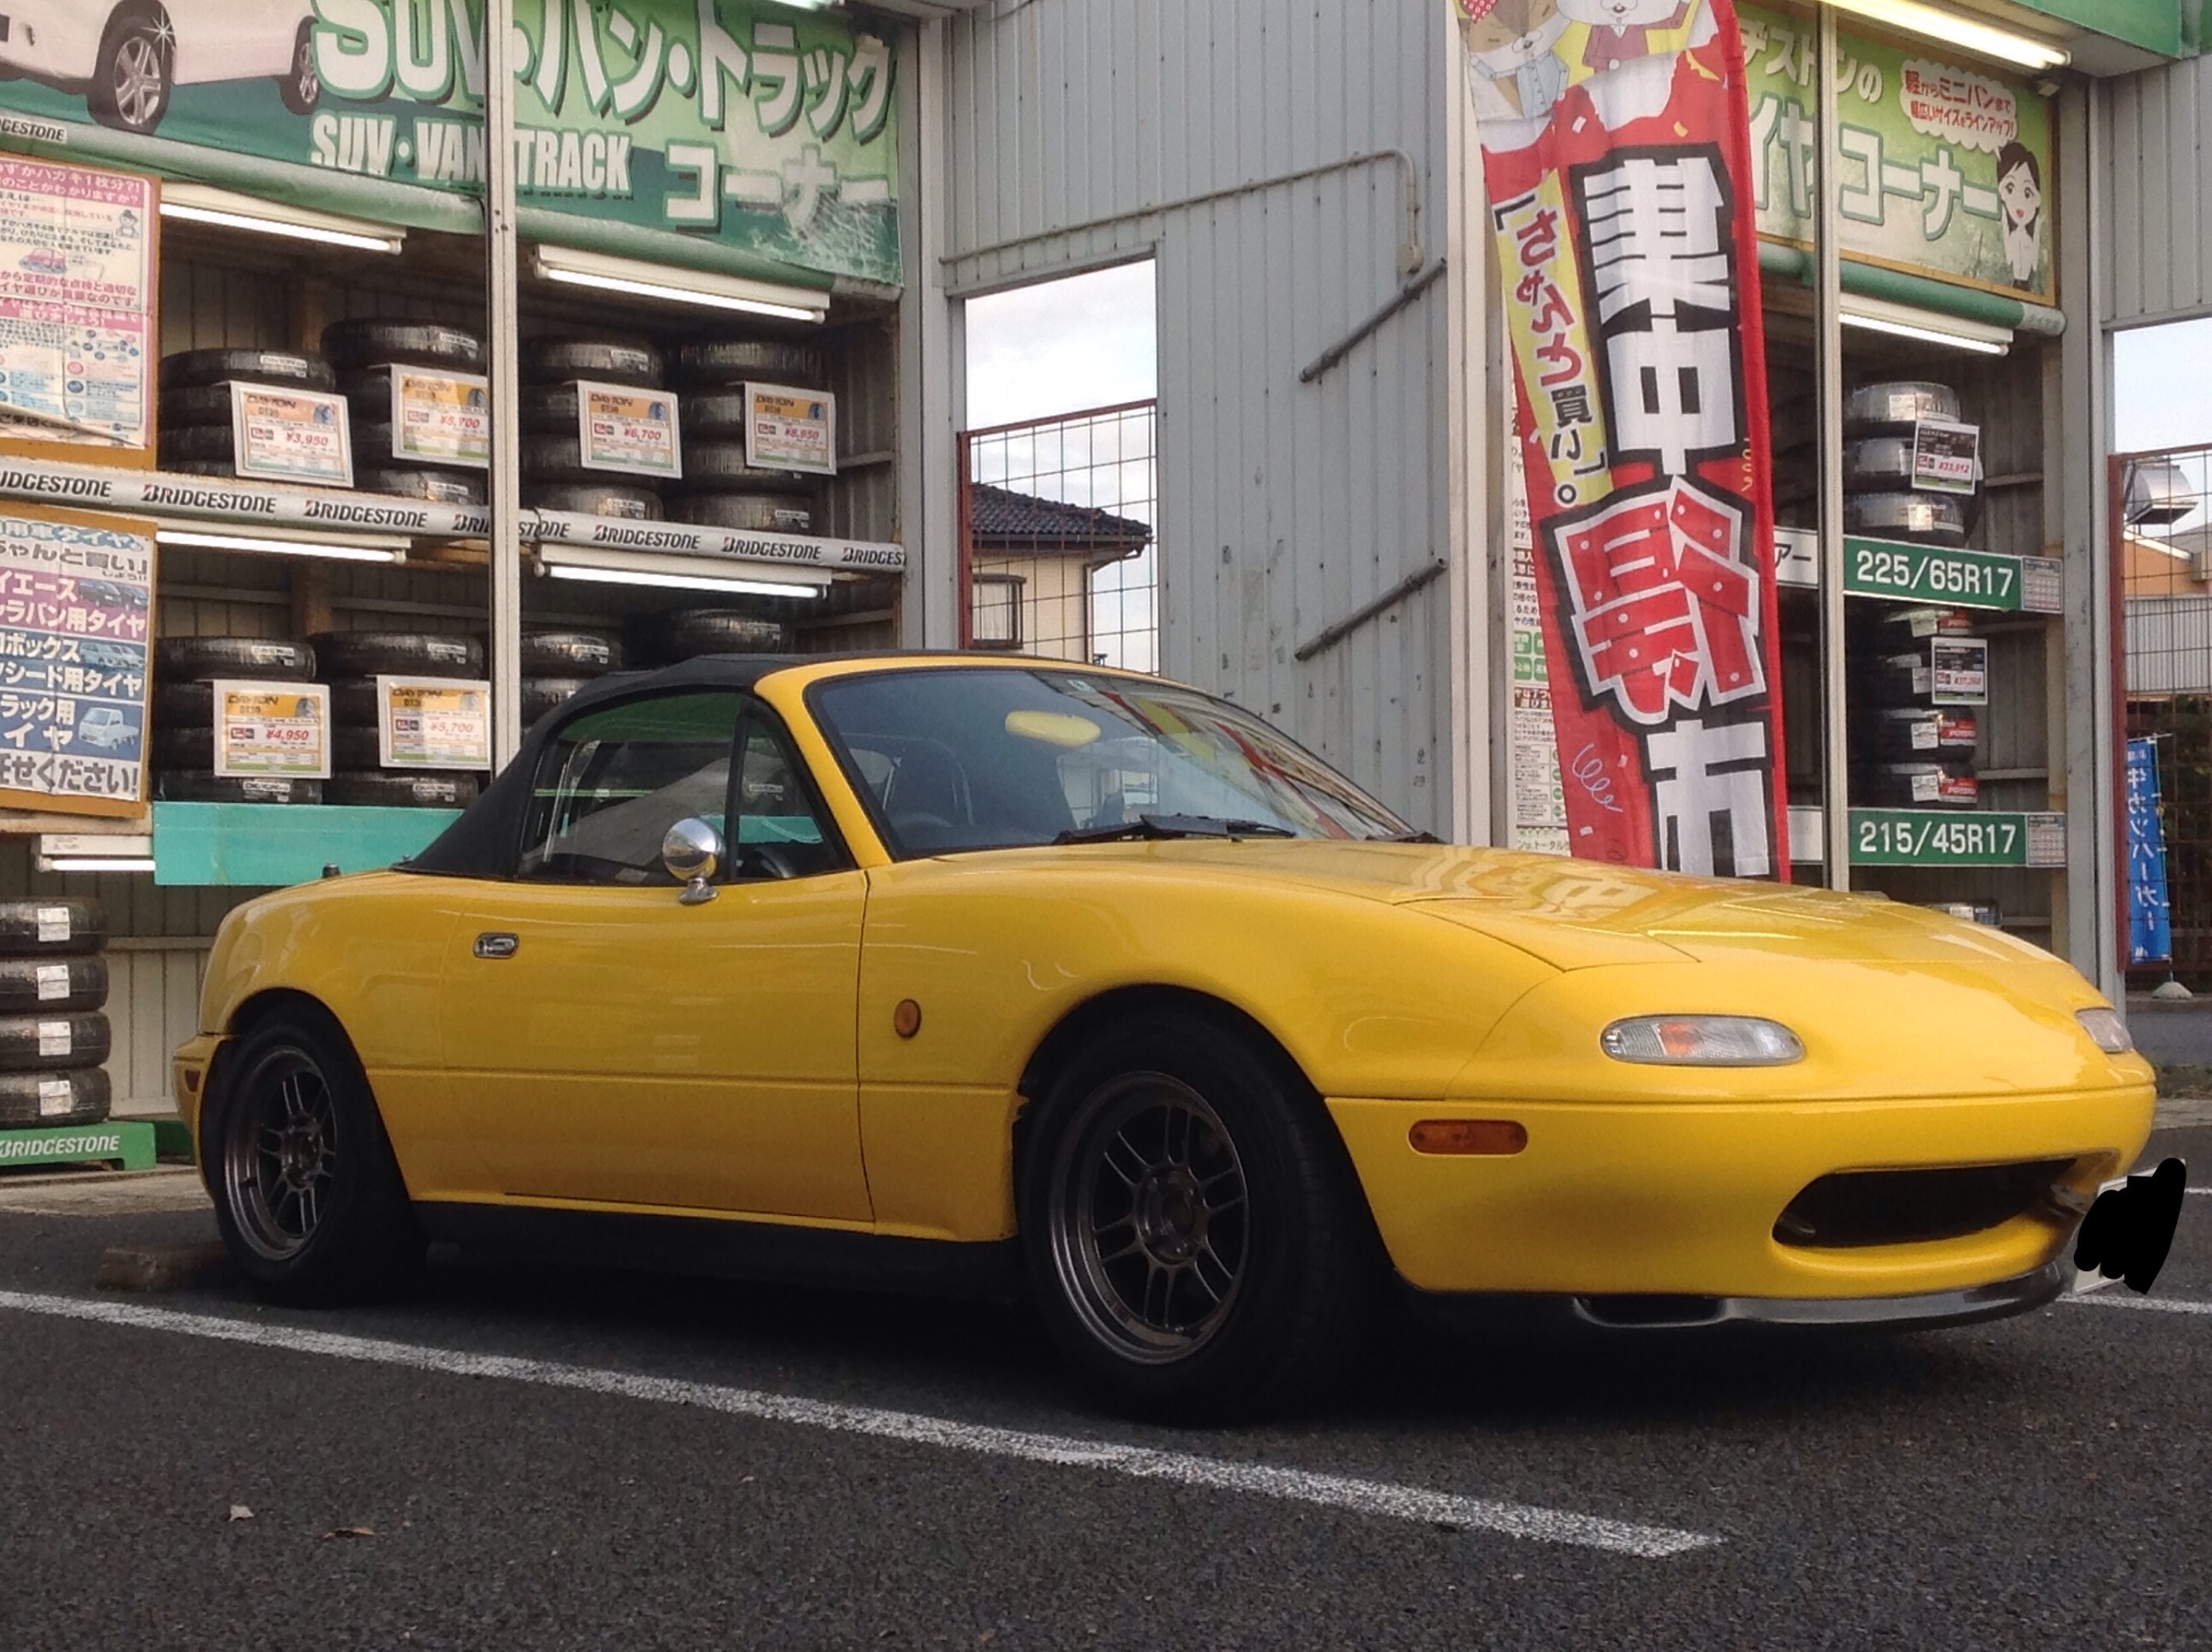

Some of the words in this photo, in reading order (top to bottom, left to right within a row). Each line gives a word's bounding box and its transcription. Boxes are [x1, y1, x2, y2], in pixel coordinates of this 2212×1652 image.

[0, 120, 64, 142] GESTONE
[666, 143, 889, 232] コーナー
[0, 470, 112, 498] IDGESTONE
[141, 483, 276, 514] BRIDGESTONE
[304, 499, 428, 529] BRIDGESTONE
[593, 523, 700, 550] BRIDGESTONE
[722, 536, 821, 560] BRIDGESTONE
[1856, 550, 2013, 597] 225/65R17
[1859, 820, 2017, 856] 215/45R17
